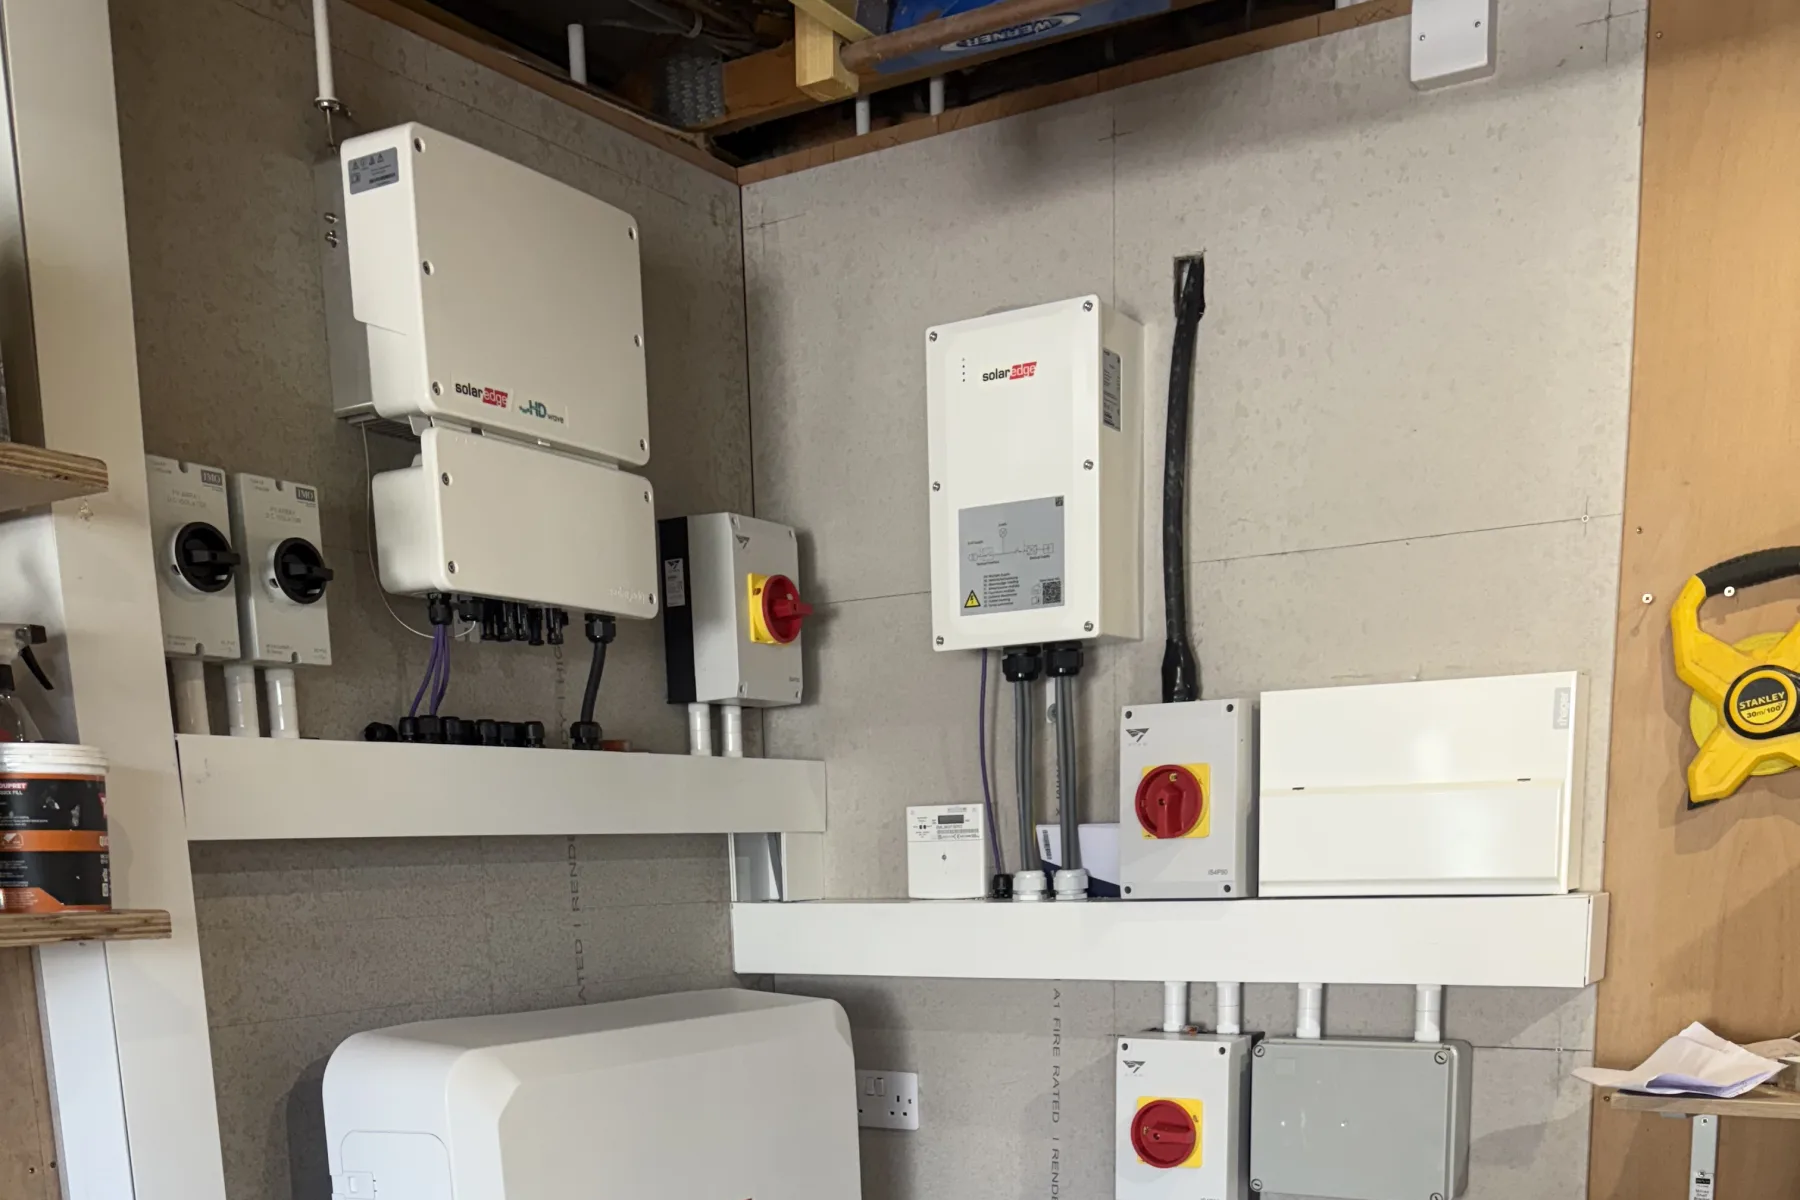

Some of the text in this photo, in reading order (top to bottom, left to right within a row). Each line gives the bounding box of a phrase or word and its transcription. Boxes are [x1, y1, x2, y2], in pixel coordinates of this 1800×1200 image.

[965, 19, 1052, 47] WERNER
[982, 361, 1038, 382] solaredge
[455, 382, 509, 408] solaredge
[202, 471, 222, 484] IMO
[297, 487, 315, 501] IMO
[1739, 691, 1785, 709] STANLEY
[573, 939, 587, 1005] ATED
[1051, 988, 1061, 1009] A1
[1052, 1017, 1061, 1057] FIRE
[1051, 1065, 1061, 1123] RATED
